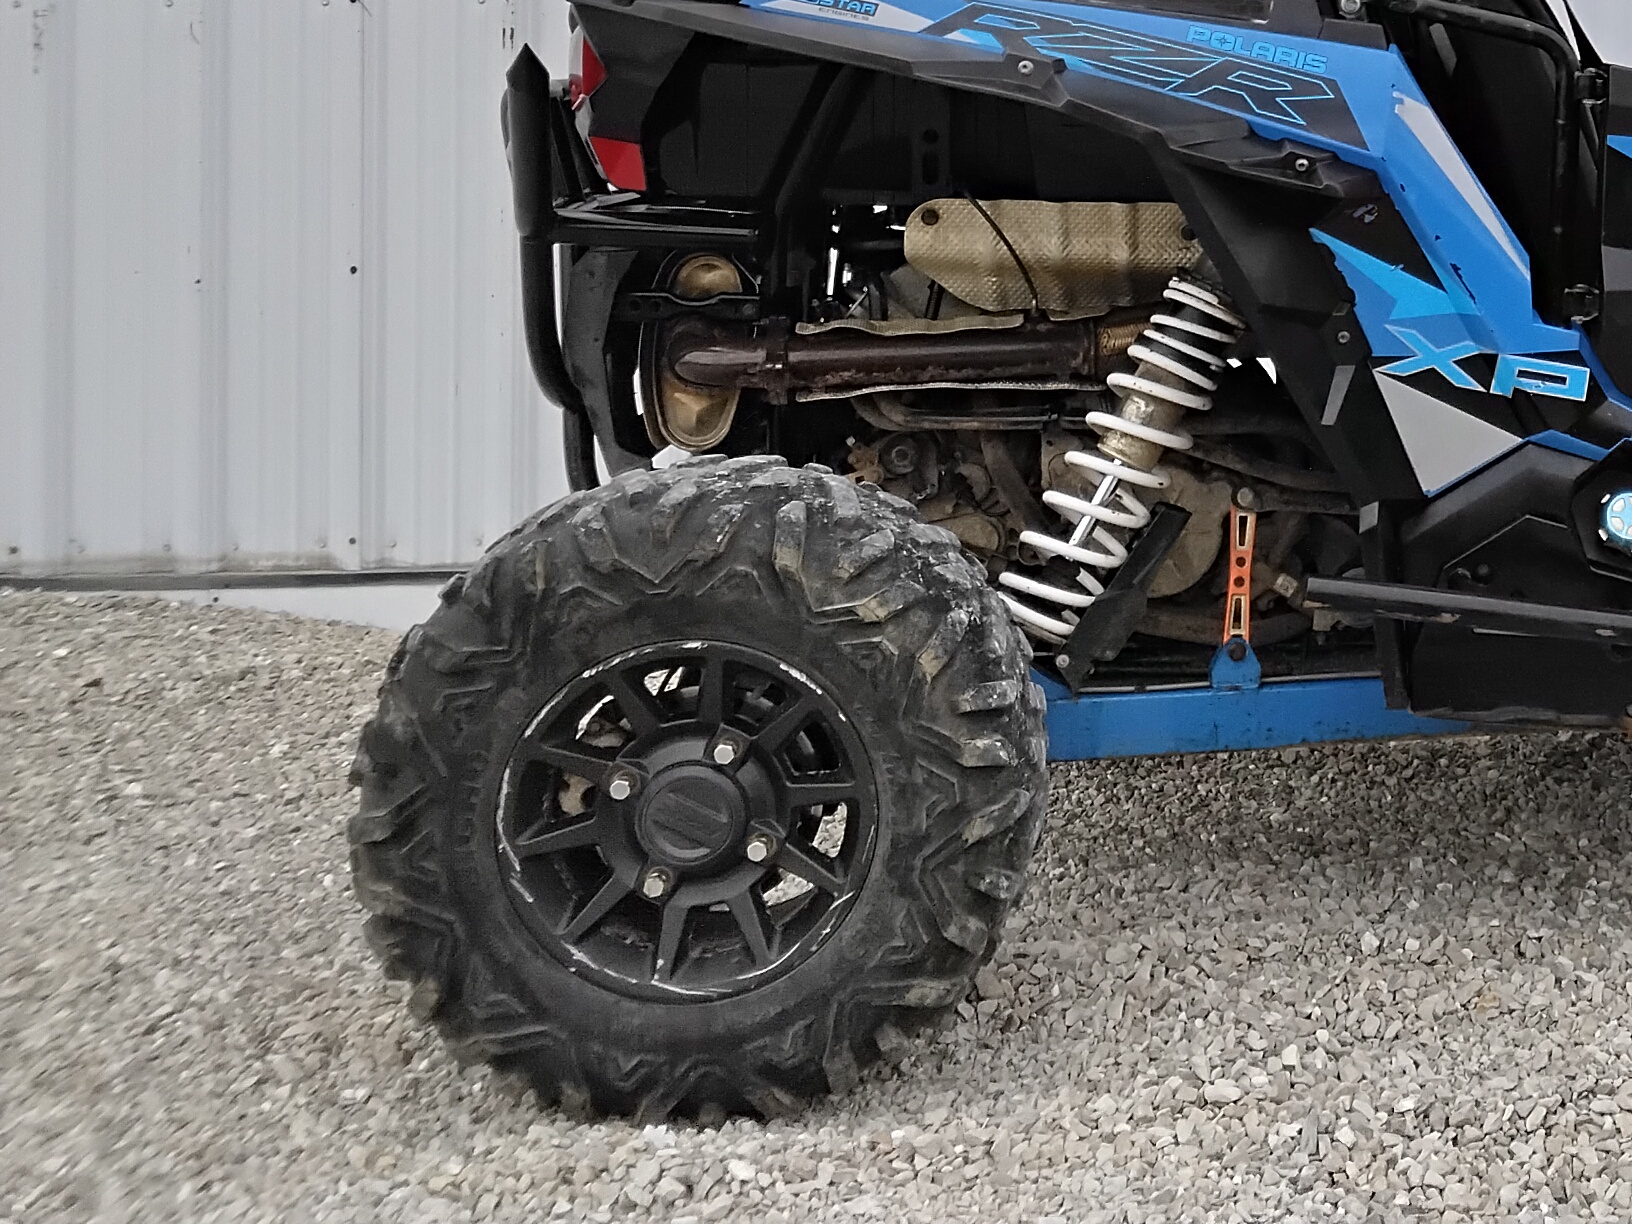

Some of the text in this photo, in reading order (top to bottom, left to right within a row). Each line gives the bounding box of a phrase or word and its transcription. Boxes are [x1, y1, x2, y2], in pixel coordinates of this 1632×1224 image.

[917, 1, 1335, 125] RZR
[1185, 24, 1328, 73] POLARIS
[1373, 324, 1590, 401] XP
